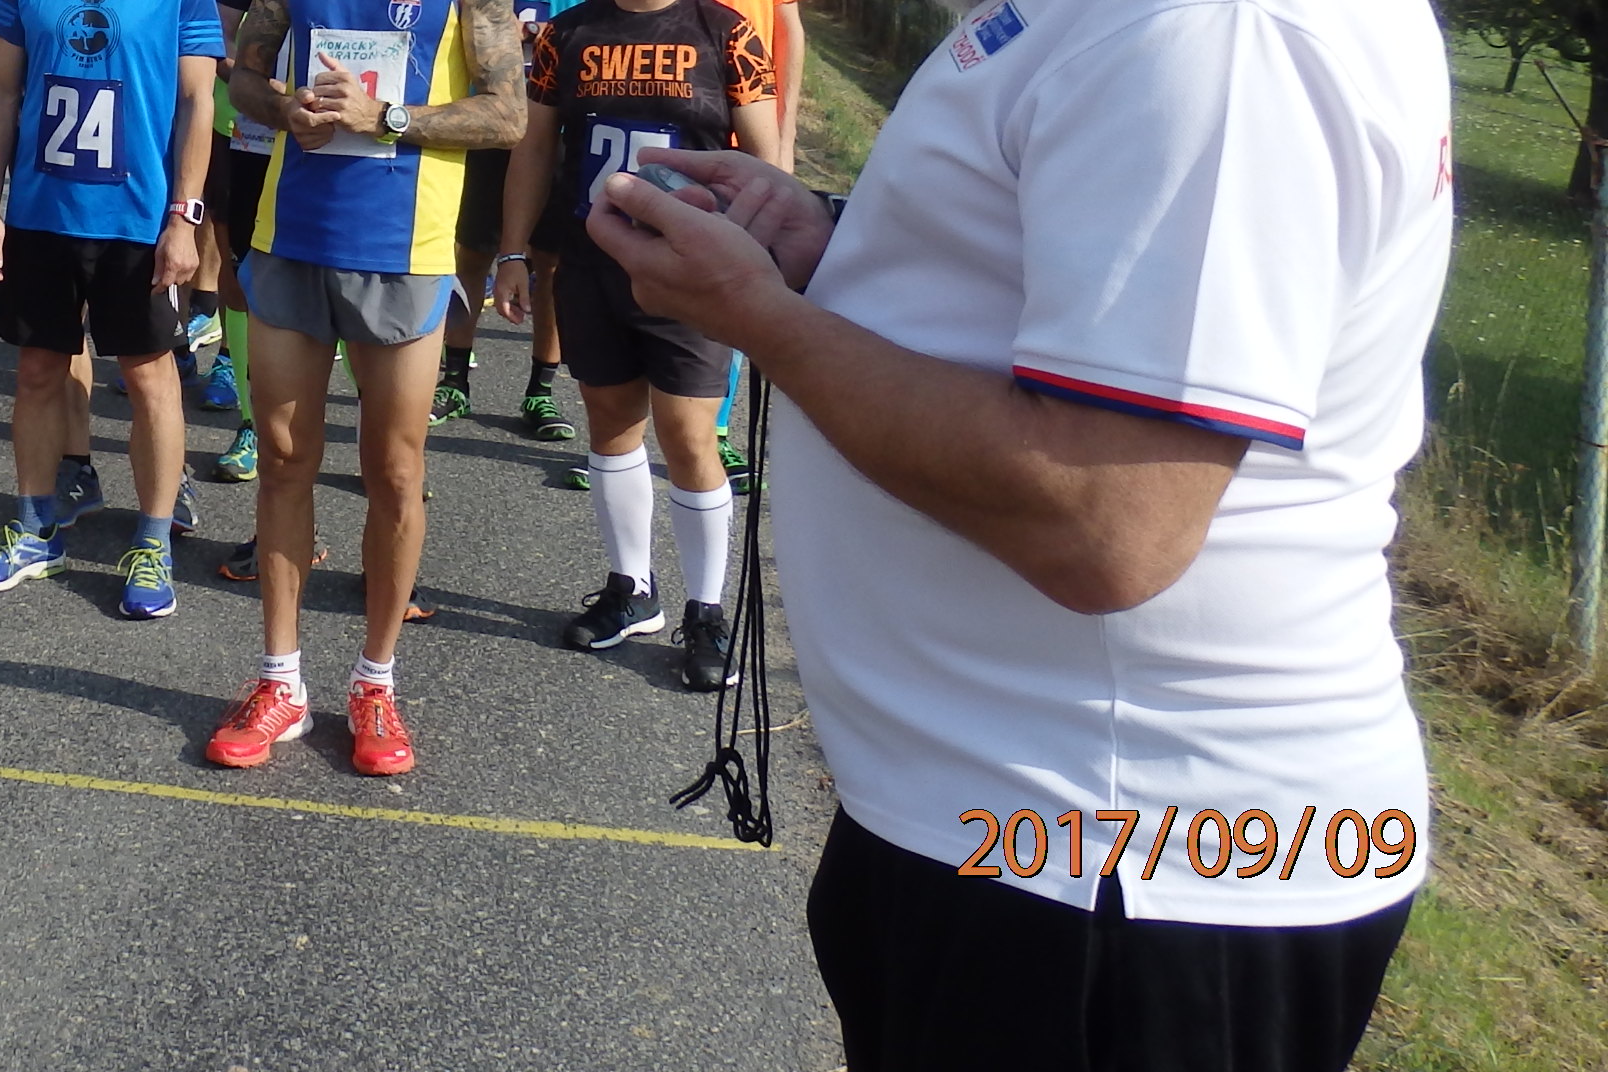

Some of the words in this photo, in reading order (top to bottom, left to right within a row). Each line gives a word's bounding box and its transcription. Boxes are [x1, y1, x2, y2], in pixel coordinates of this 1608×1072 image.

[579, 44, 698, 82] SWEEP
[576, 80, 627, 98] SPORTS
[629, 80, 693, 99] CLOTHING
[44, 85, 115, 169] 24
